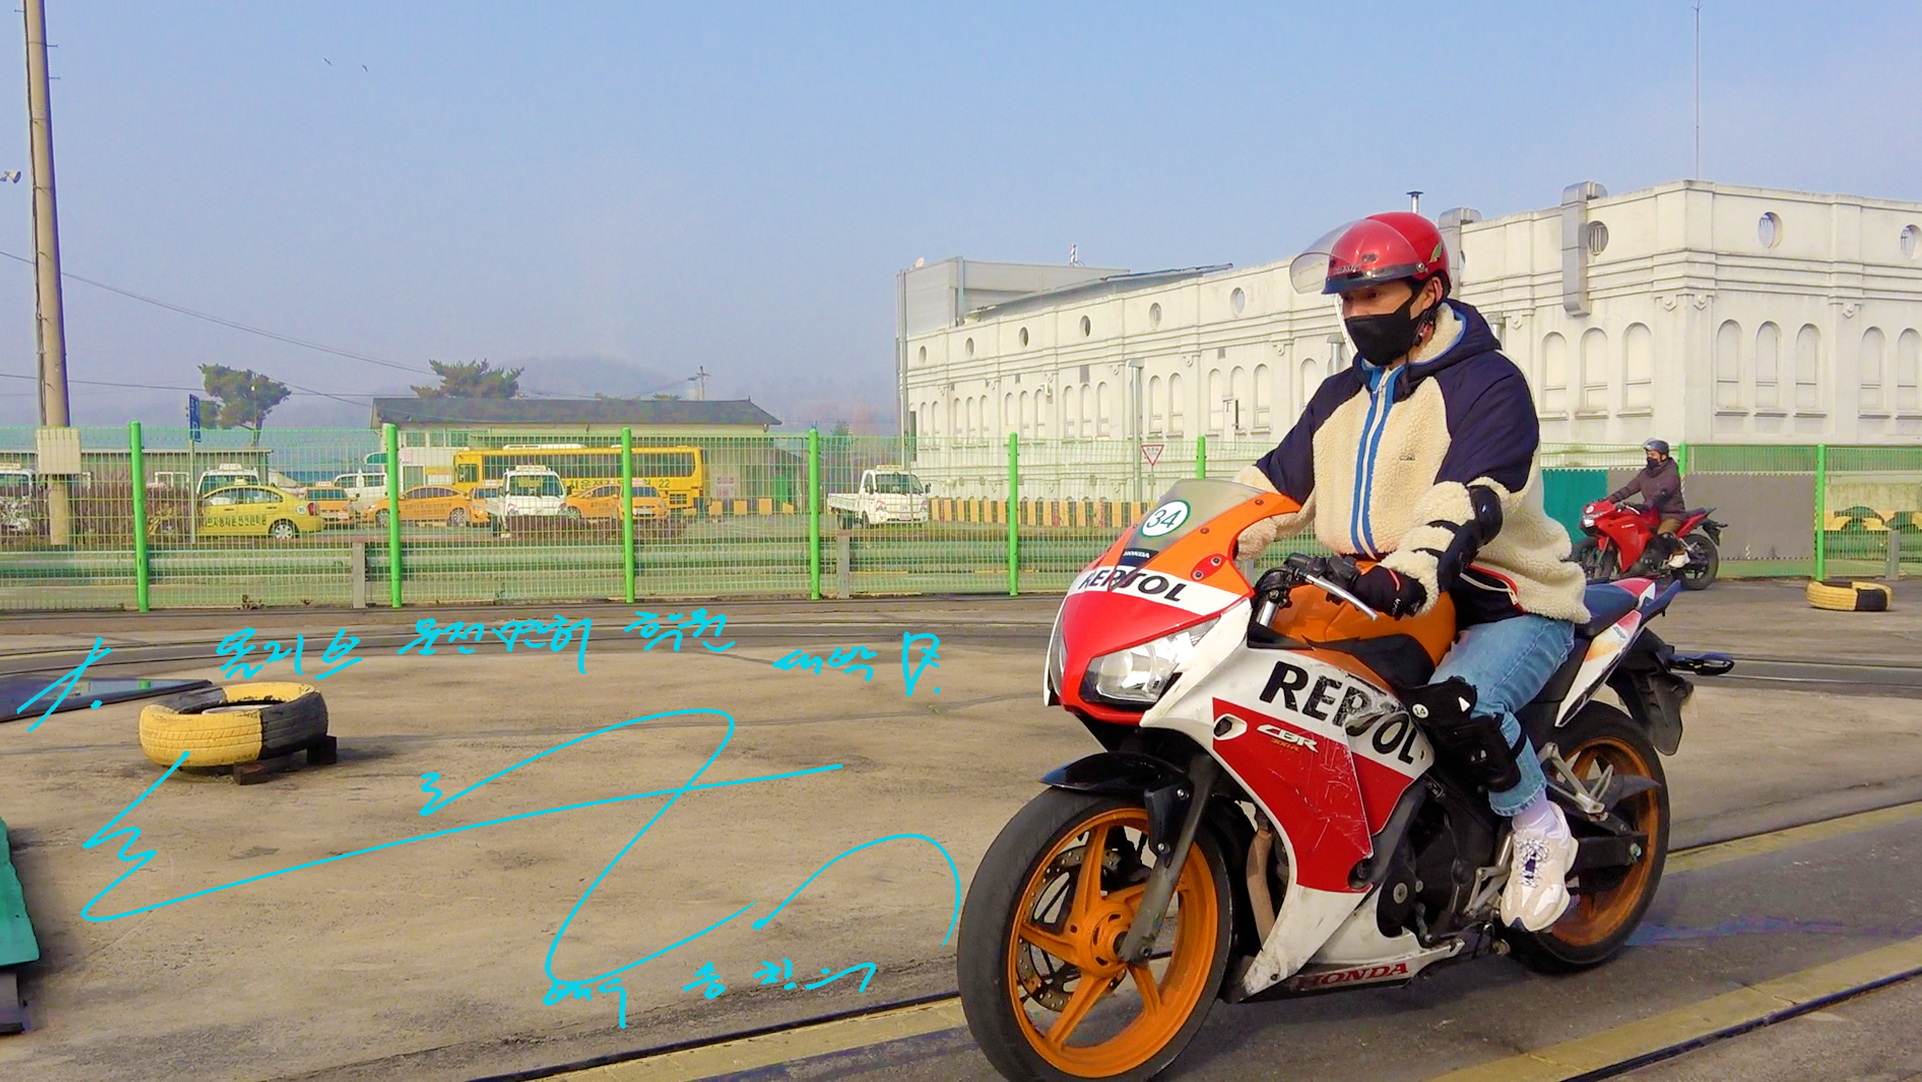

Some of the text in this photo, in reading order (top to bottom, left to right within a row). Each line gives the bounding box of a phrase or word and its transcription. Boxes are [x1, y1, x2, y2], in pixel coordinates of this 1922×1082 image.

[658, 478, 671, 489] 22
[1146, 509, 1182, 529] 34
[1256, 724, 1320, 754] CBR
[1298, 962, 1409, 990] HONDA
